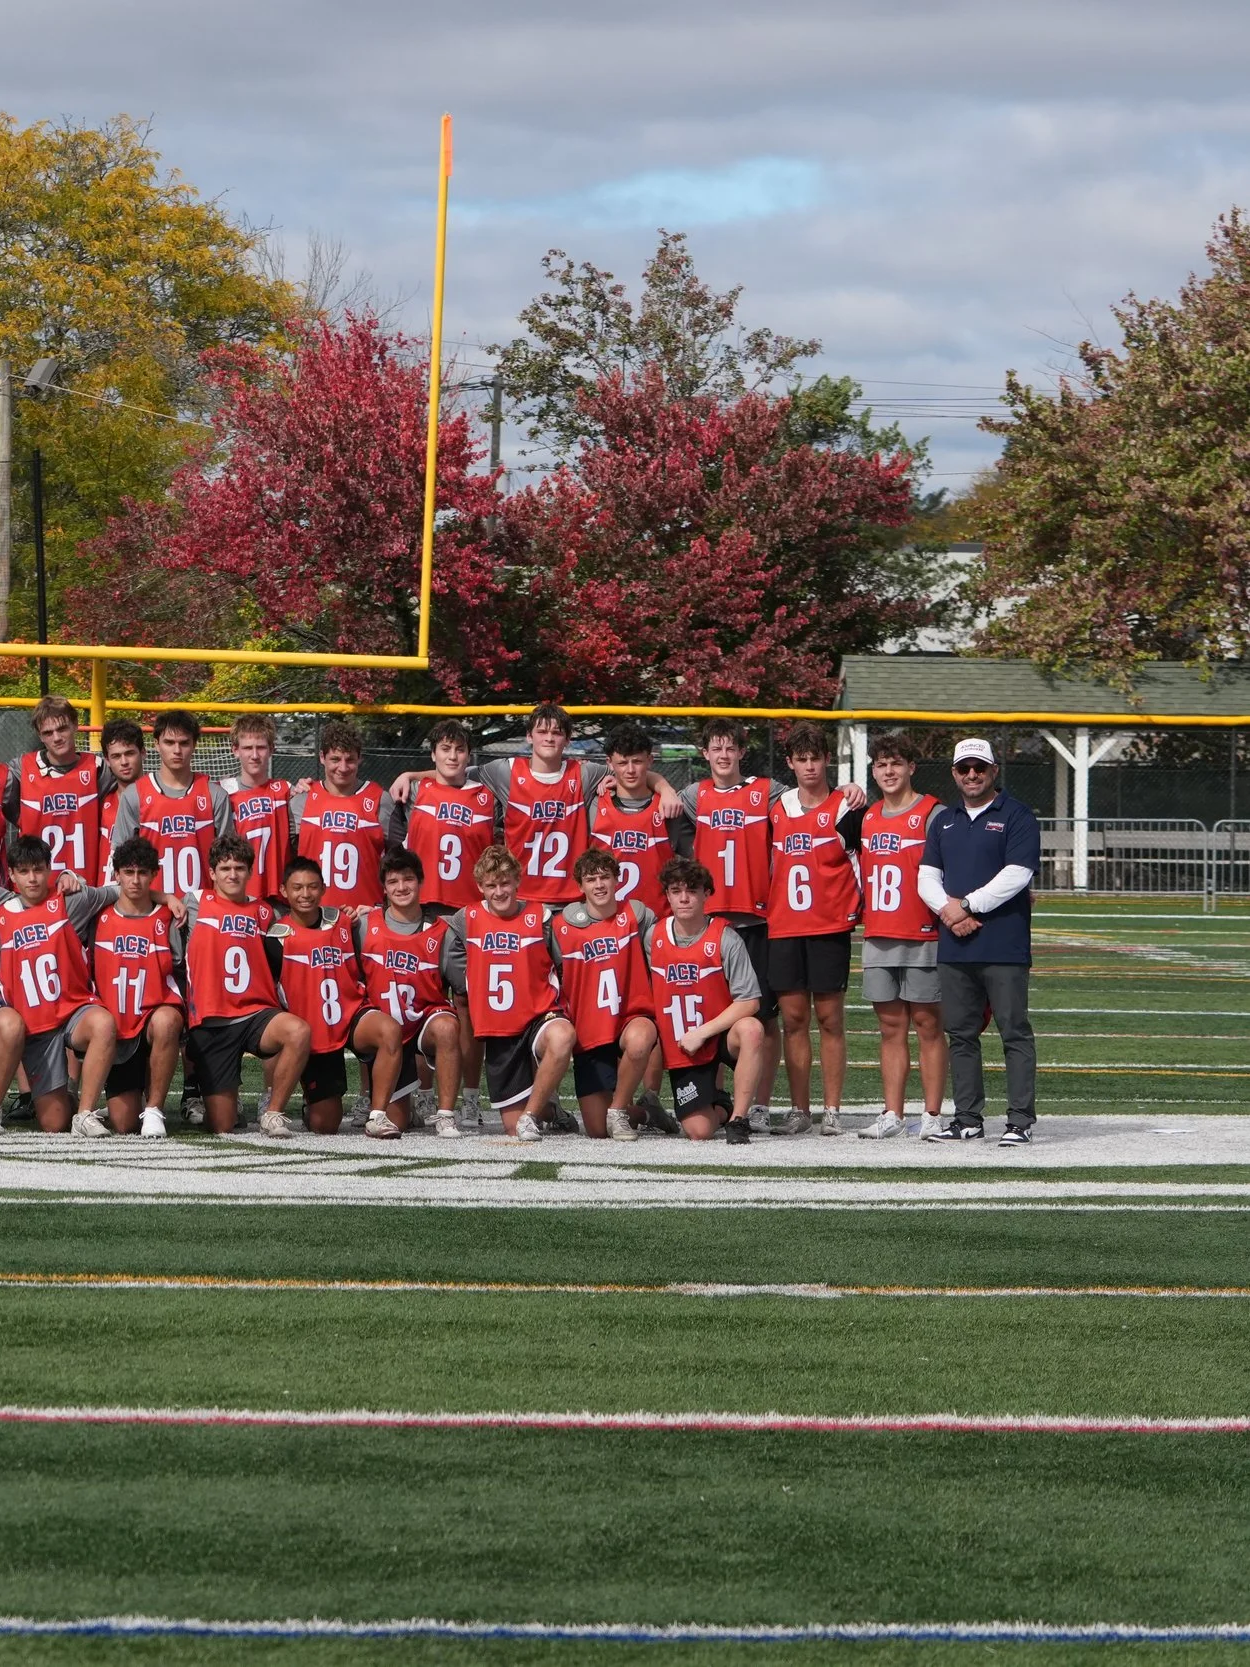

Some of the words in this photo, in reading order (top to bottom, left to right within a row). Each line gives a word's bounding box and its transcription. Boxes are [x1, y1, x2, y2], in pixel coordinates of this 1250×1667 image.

[42, 793, 78, 815] ACE
[238, 797, 273, 822] ACE
[436, 802, 473, 827] ACE
[531, 800, 566, 821] ACE
[161, 815, 195, 835] ACE
[321, 811, 357, 832] ACE
[710, 808, 744, 829] ACE
[42, 823, 85, 870] 21
[246, 826, 271, 874] 7
[524, 831, 570, 878] 12
[612, 830, 648, 851] ACE
[784, 833, 812, 854] ACE
[868, 832, 900, 853] ACE
[158, 846, 201, 894] 10
[319, 840, 359, 890] 19
[438, 834, 462, 881] 3
[717, 840, 735, 887] 1
[615, 861, 640, 901] 2
[787, 865, 813, 912] 6
[867, 864, 902, 912] 18
[13, 923, 48, 951] ACE
[220, 915, 255, 937] ACE
[113, 935, 149, 957] ACE
[482, 932, 519, 952] ACE
[583, 937, 618, 963] ACE
[224, 946, 251, 994] 9
[311, 946, 342, 968] ACE
[385, 950, 419, 974] ACE
[20, 953, 61, 1007] 16
[488, 964, 514, 1011] 5
[666, 964, 699, 984] ACE
[112, 967, 146, 1015] 11
[320, 978, 342, 1026] 8
[597, 968, 621, 1015] 4
[663, 994, 703, 1041] 15
